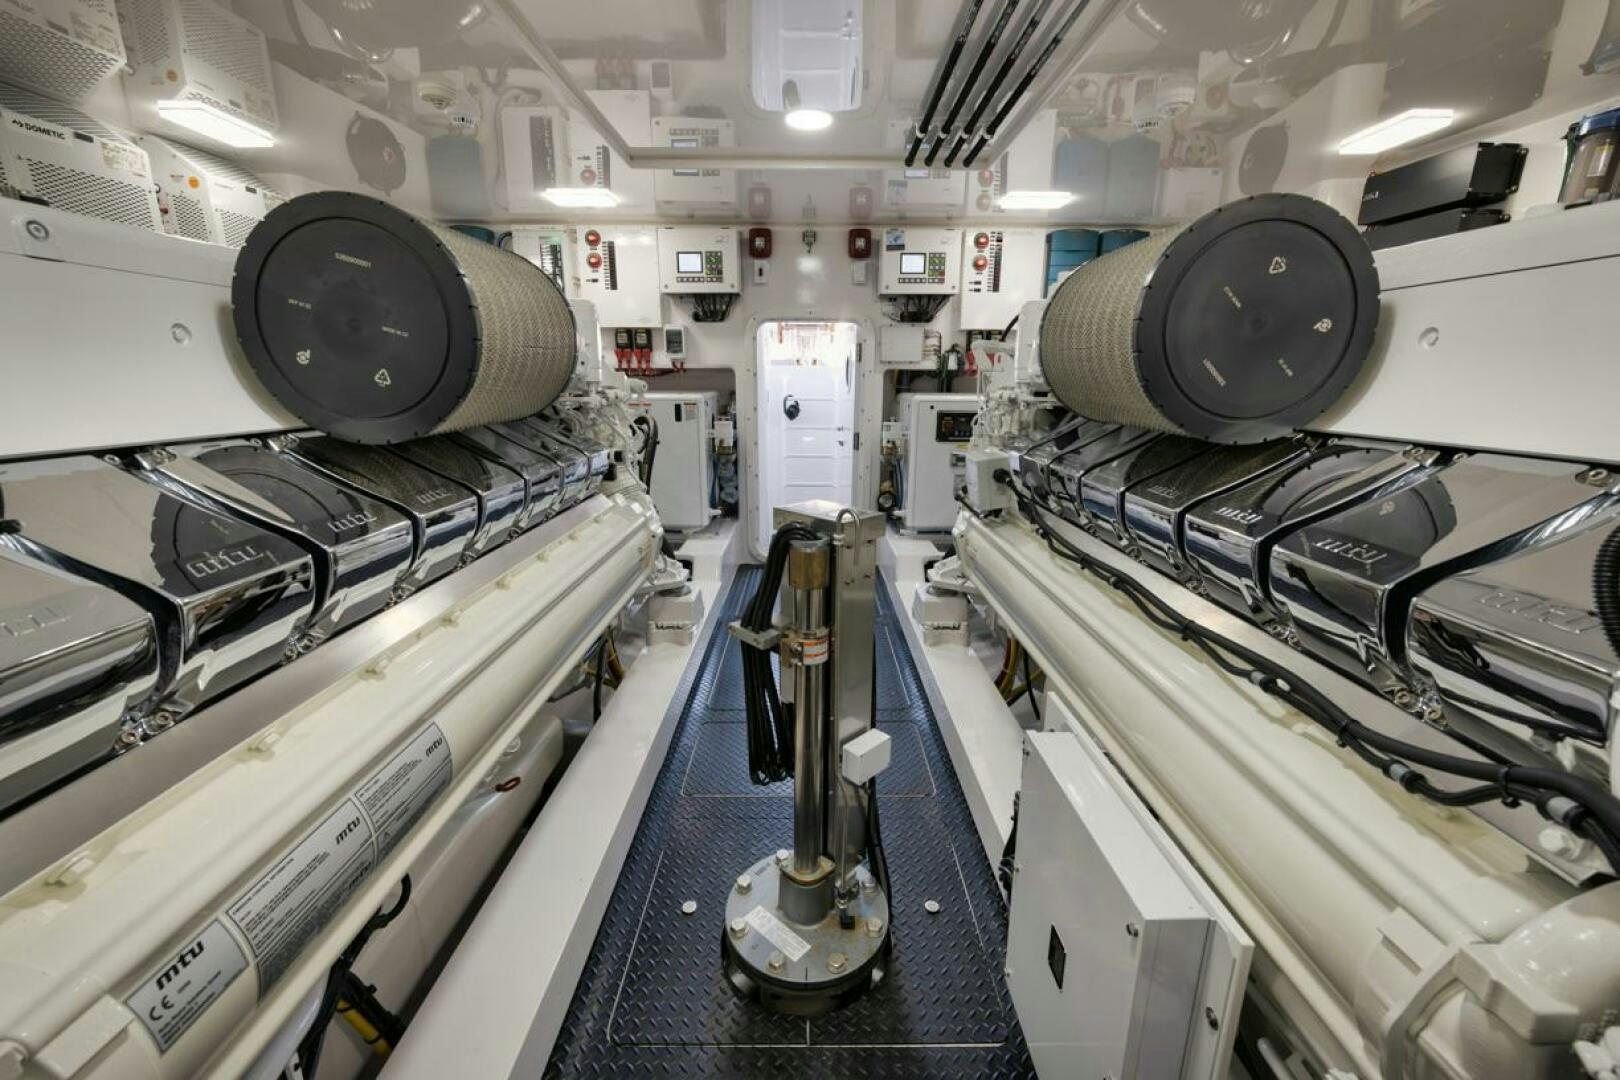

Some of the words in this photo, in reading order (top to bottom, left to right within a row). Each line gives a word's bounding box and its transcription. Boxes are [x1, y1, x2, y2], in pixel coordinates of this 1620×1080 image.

[24, 121, 66, 140] DOMETIC
[1311, 538, 1388, 563] mtu
[425, 737, 443, 758] mtu
[335, 816, 361, 845] mtu
[155, 940, 205, 991] mtu
